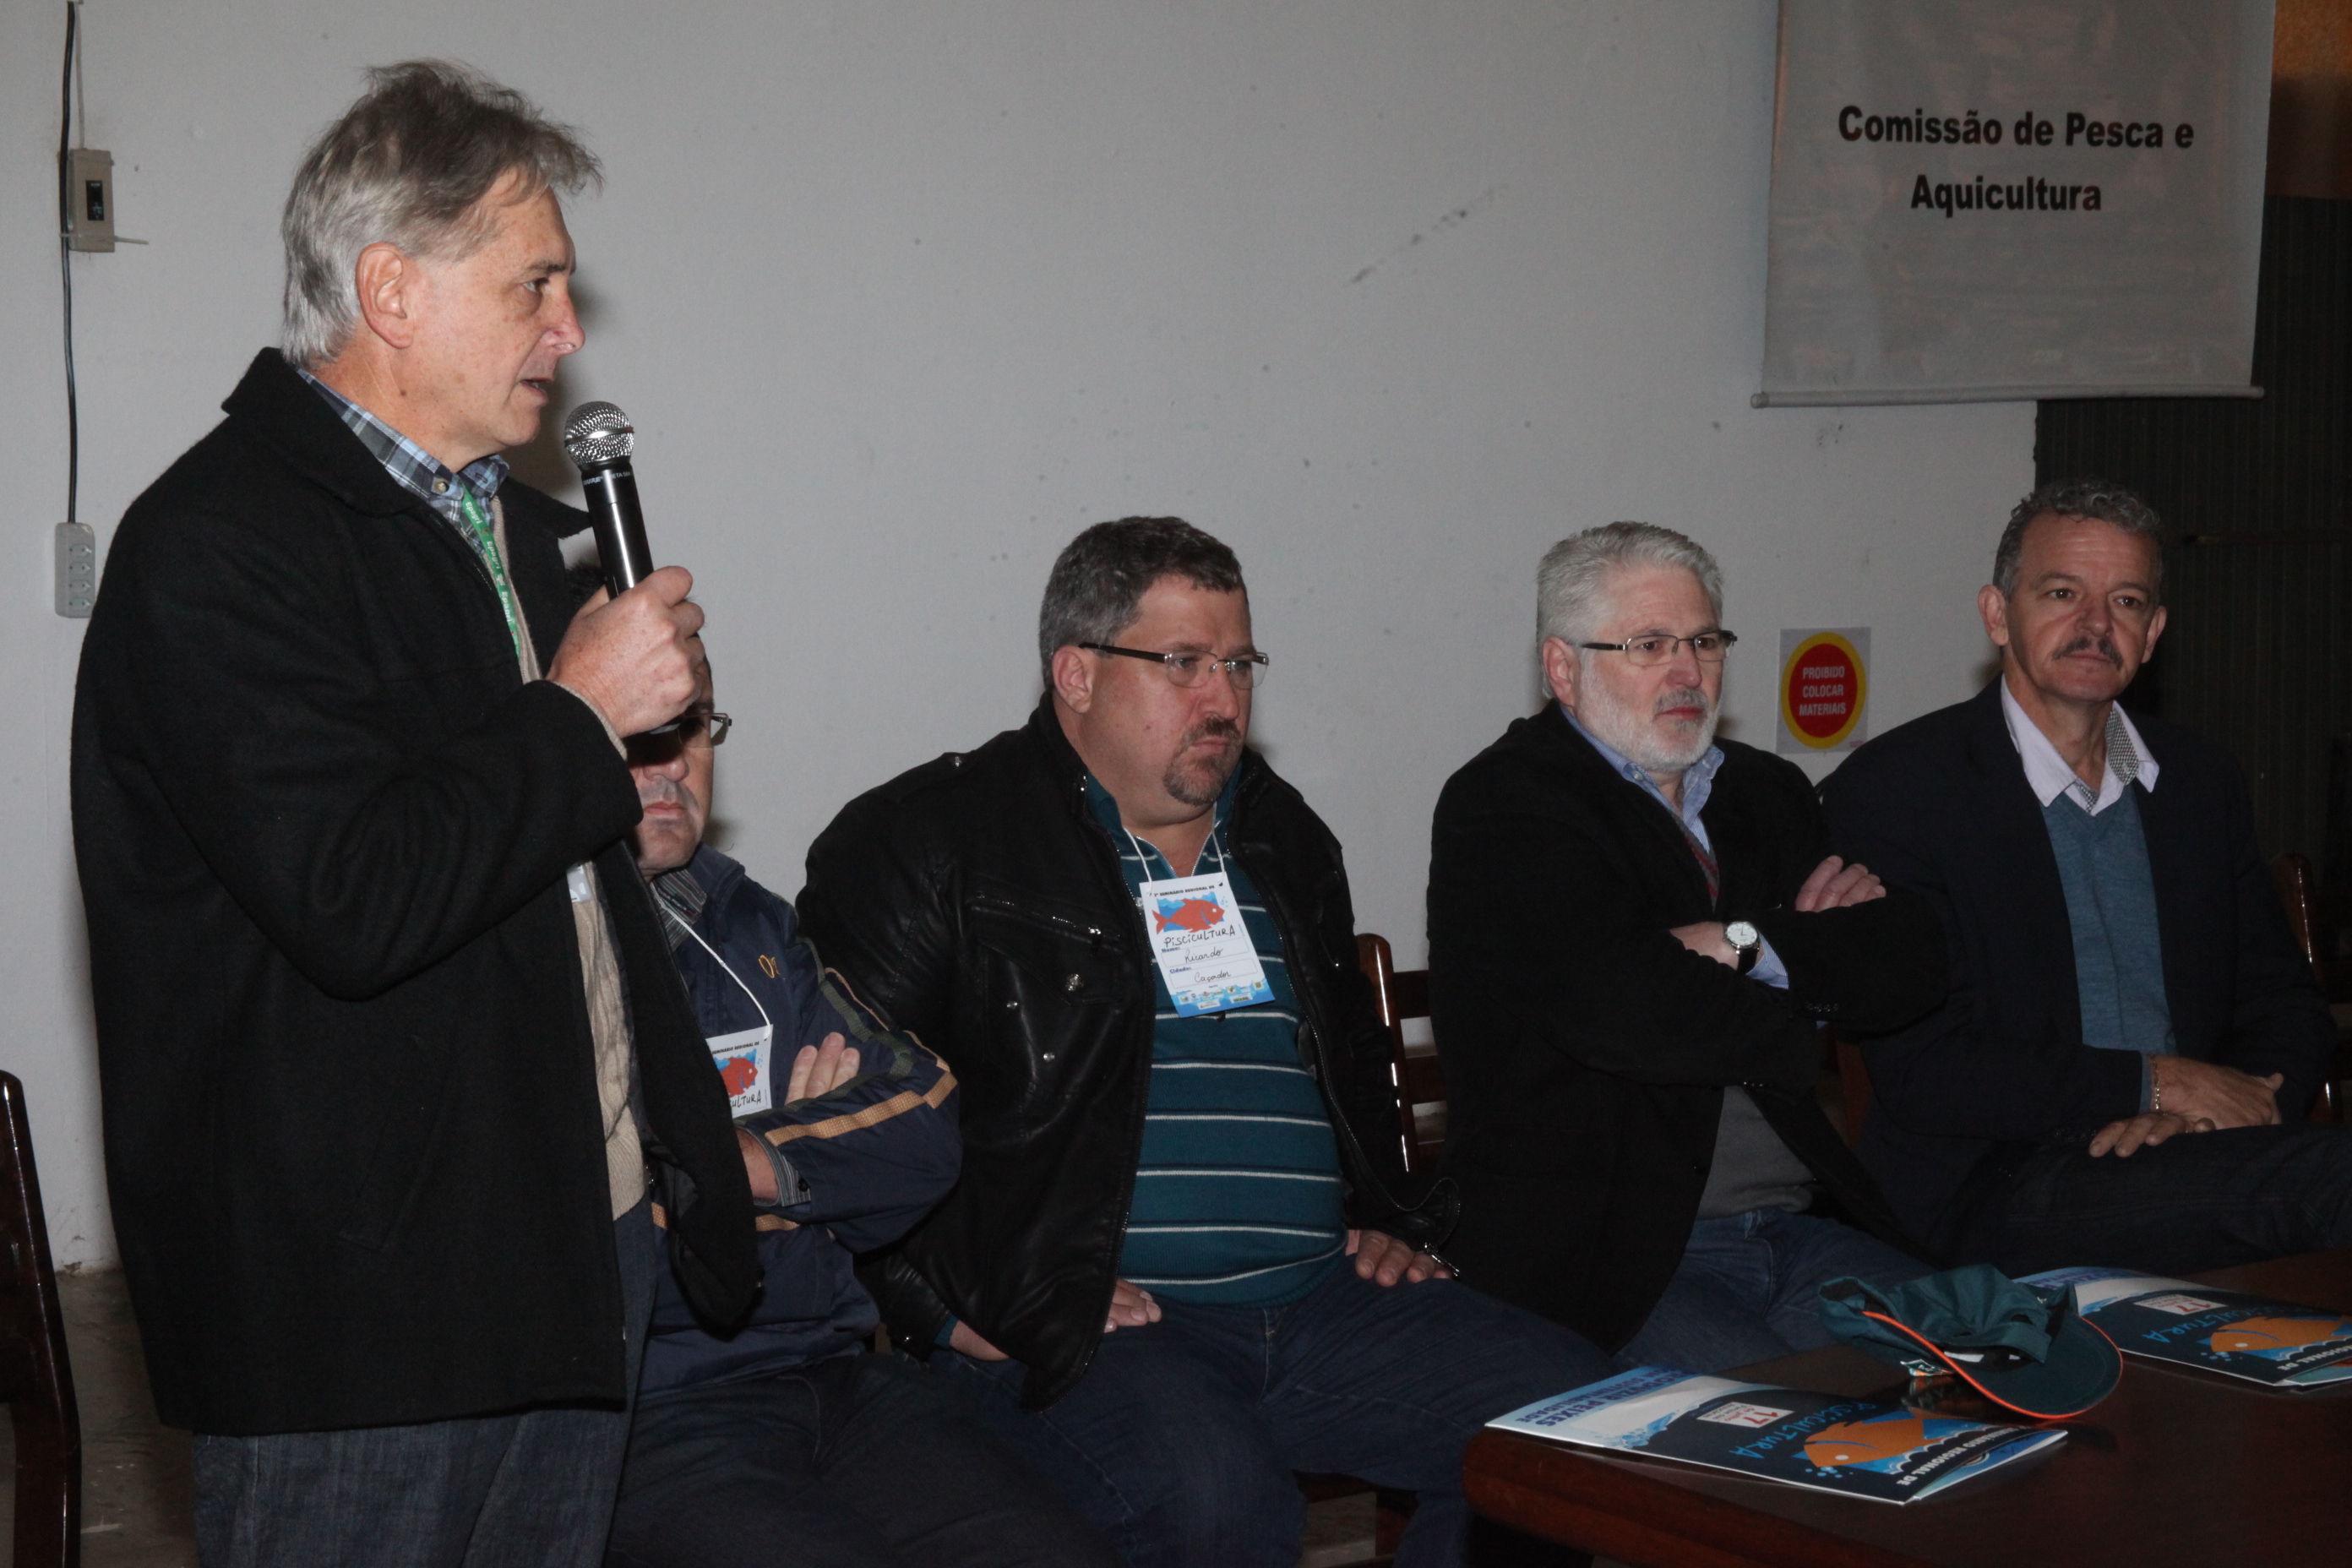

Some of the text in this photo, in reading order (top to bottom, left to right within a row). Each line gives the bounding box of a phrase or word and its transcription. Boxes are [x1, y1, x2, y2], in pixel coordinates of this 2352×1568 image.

[1838, 106, 2195, 148] Comissão de Pesca e
[1911, 174, 2102, 218] Aquicultura
[466, 501, 483, 524] Epagri
[487, 541, 501, 569] Epagri
[501, 591, 513, 622] Epagri
[1803, 666, 1845, 679] PROIBIDO
[1803, 684, 1843, 698] COLOCAR
[1799, 702, 1846, 716] MATERIAIS
[1184, 946, 1223, 963] Ricardo
[2277, 1362, 2299, 1371] DE
[1535, 1400, 1604, 1426] PEIXES
[1743, 1412, 1778, 1425] 17
[1911, 1446, 1968, 1475] REGIONAL
[1896, 1475, 1917, 1486] DE
